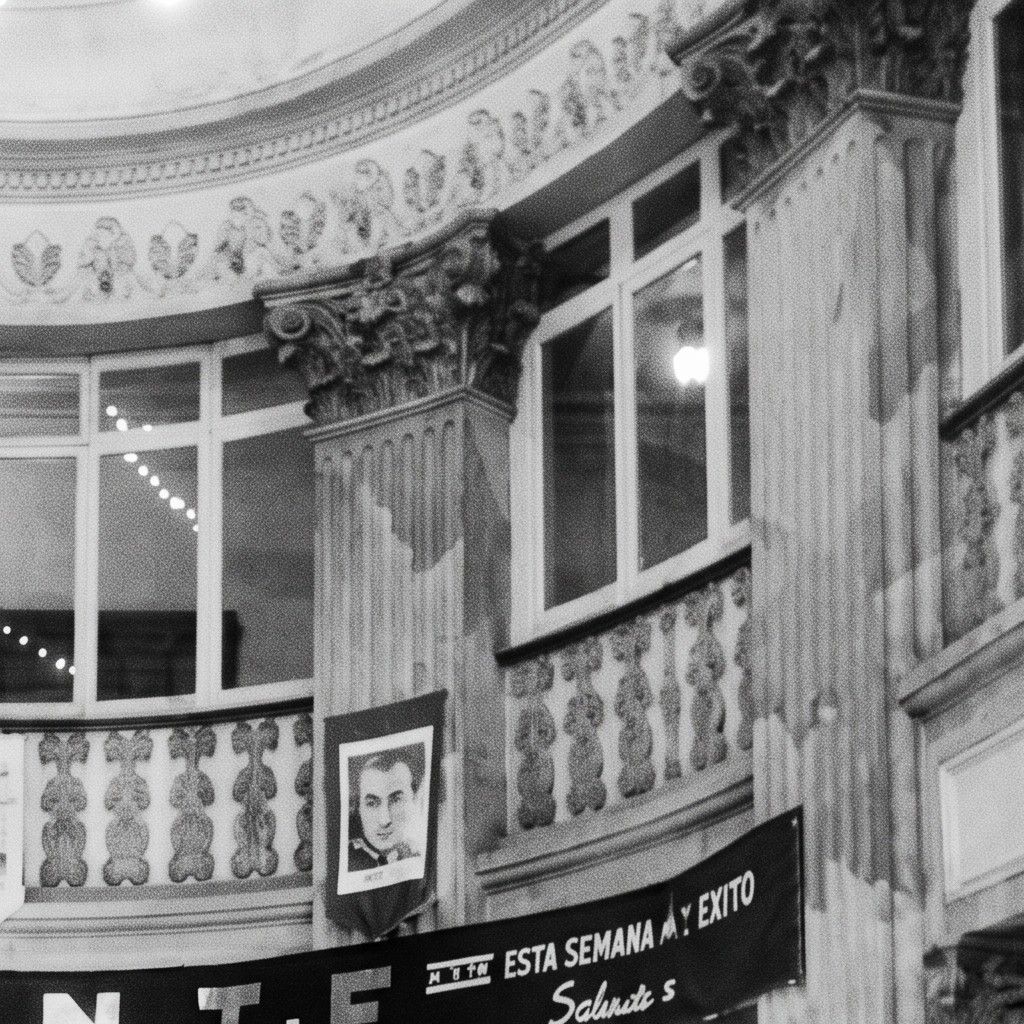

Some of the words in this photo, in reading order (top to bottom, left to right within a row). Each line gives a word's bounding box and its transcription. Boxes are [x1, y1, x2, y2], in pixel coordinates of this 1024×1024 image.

[504, 942, 558, 980] ESTA
[563, 919, 655, 968] SEMANA
[697, 870, 755, 929] EXITO
